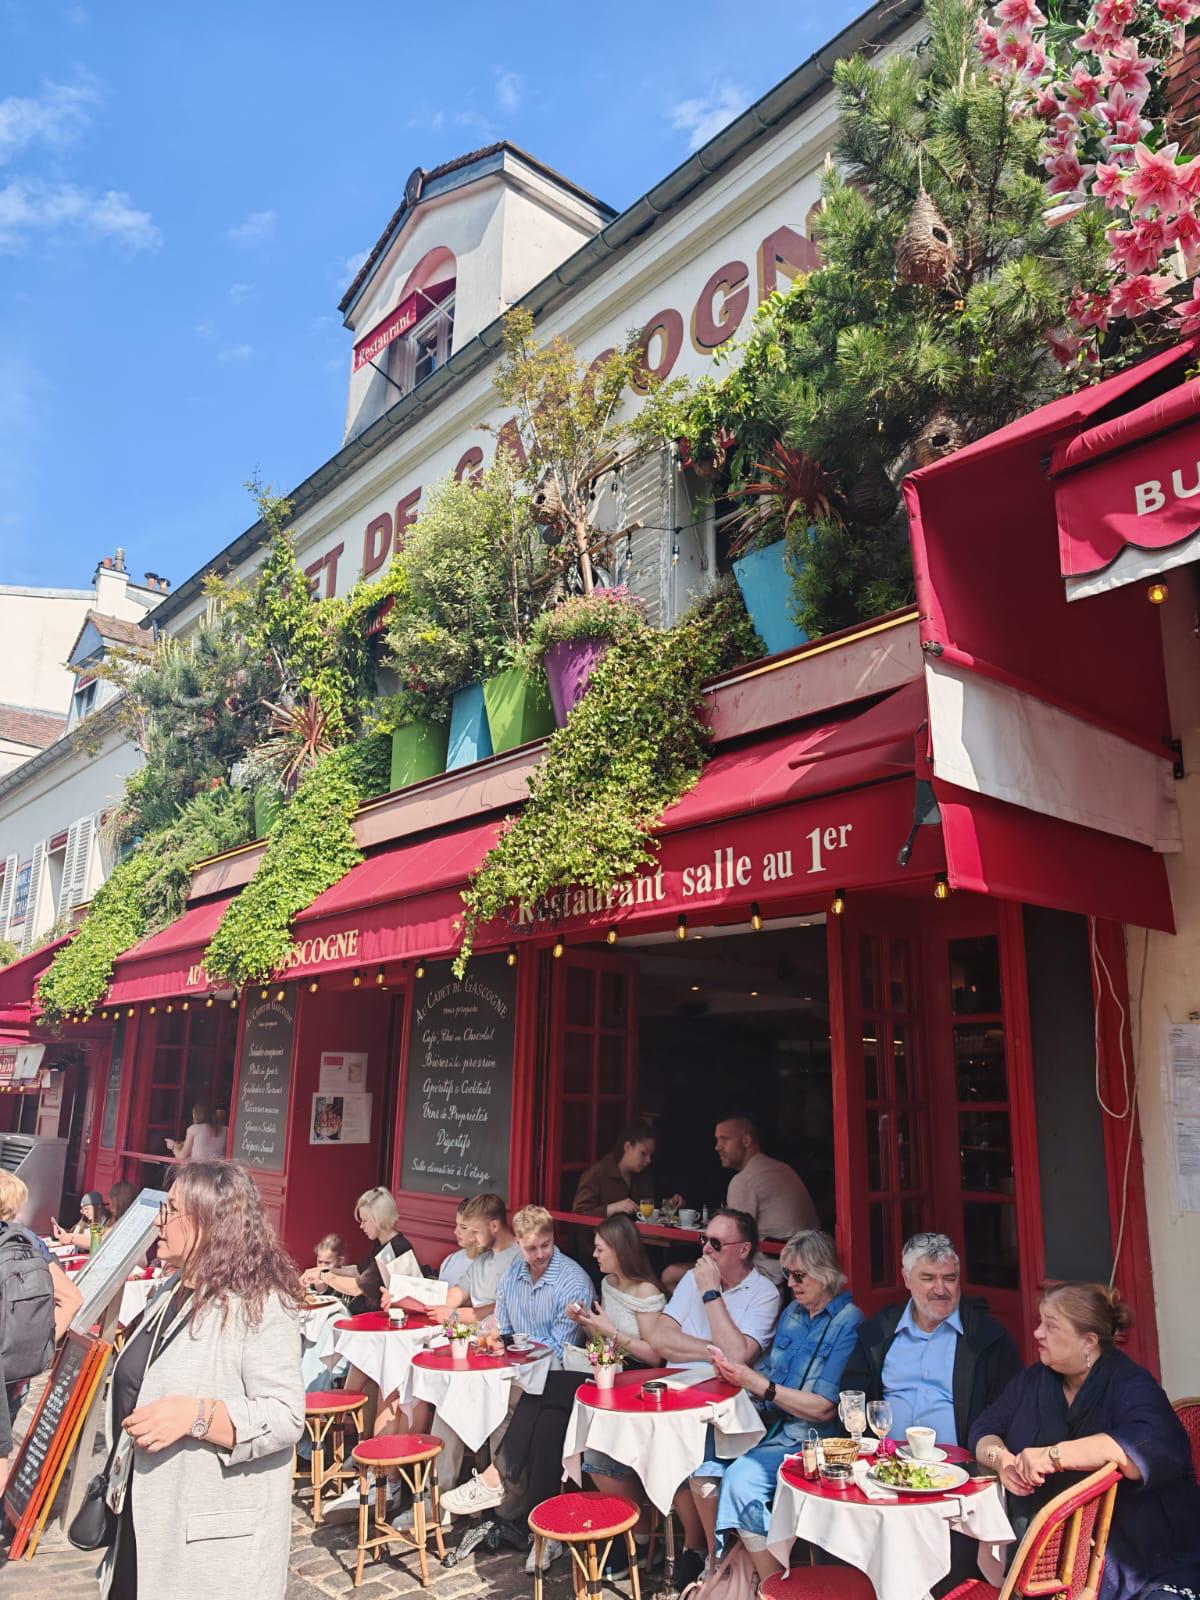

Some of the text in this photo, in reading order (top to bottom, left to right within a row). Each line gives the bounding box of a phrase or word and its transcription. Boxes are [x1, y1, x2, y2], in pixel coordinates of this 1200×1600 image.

[358, 309, 411, 366] Restaurant
[363, 486, 422, 579] DE
[682, 846, 753, 897] salle
[762, 850, 794, 882] au
[805, 823, 853, 874] 1er
[461, 1080, 492, 1095] Cocktails
[436, 1128, 471, 1157] Digestifs
